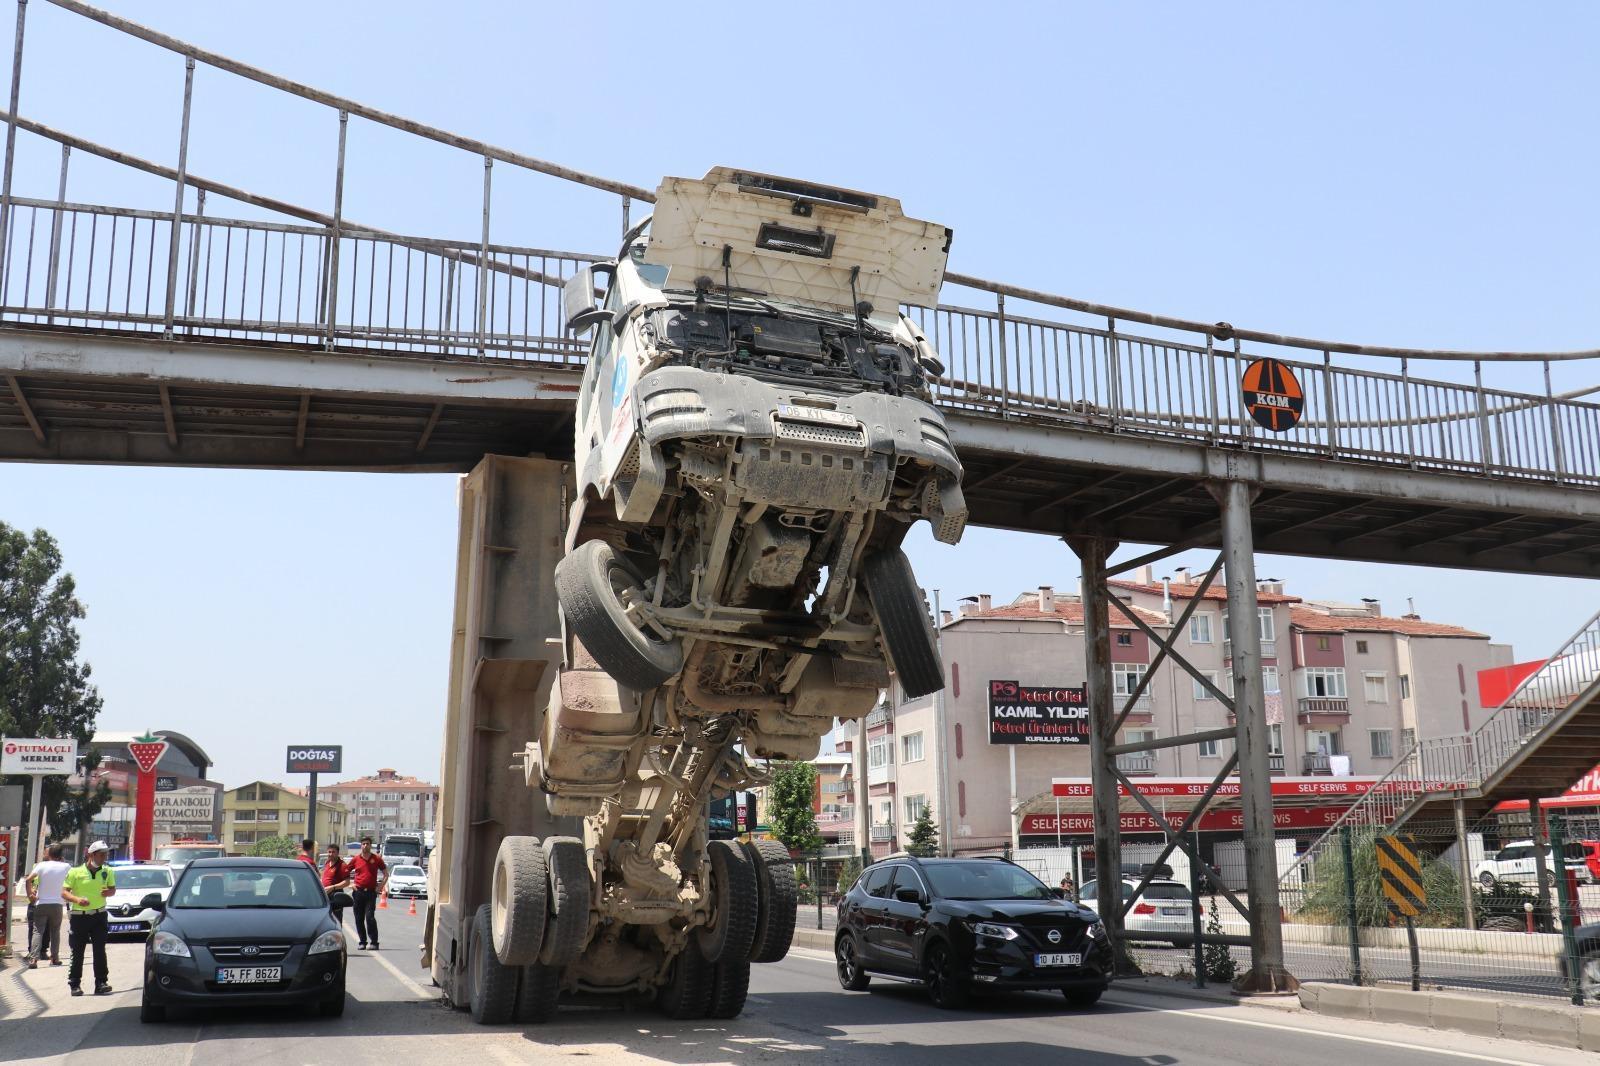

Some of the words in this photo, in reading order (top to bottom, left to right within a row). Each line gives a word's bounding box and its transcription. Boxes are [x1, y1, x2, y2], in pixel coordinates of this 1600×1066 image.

[1256, 393, 1289, 408] KGM
[786, 406, 801, 416] 06
[1020, 689, 1053, 702] Petrol
[1055, 690, 1082, 703] Ofisi
[1046, 706, 1089, 719] YILDIR
[992, 721, 1025, 734] Petrol
[1029, 719, 1073, 735] Ürünleri
[21, 755, 64, 763] MERMER
[290, 749, 335, 761] DOĞTAŞ
[1068, 786, 1091, 795] SELF
[1150, 786, 1174, 794] Yıkama
[1187, 785, 1209, 794] SELF
[1298, 784, 1318, 793] SELF
[154, 797, 211, 807] AFRANBOLU
[154, 808, 210, 818] OKUMCUSU
[1031, 819, 1058, 829] SELF
[1120, 817, 1146, 828] SELF
[1040, 955, 1048, 964] 10
[1051, 954, 1064, 964] AFA
[223, 969, 235, 980] 34
[240, 968, 252, 979] FF
[255, 968, 279, 979] 8622
